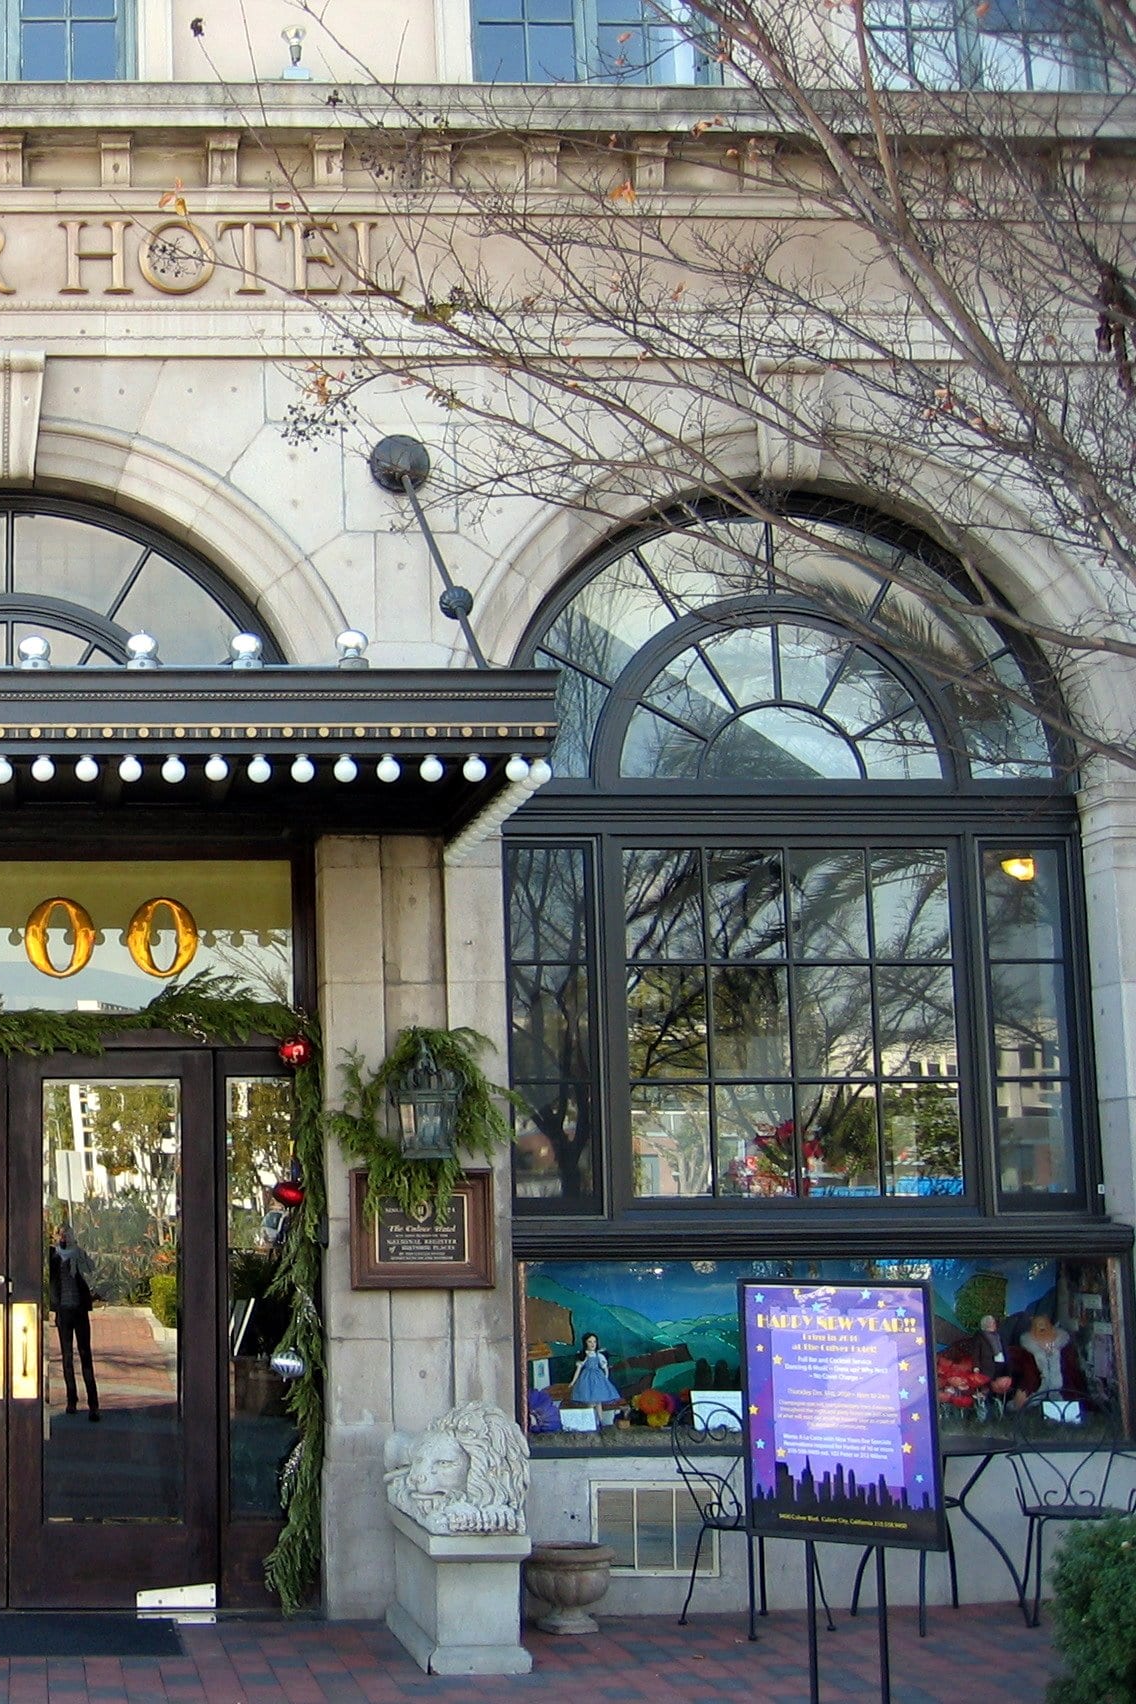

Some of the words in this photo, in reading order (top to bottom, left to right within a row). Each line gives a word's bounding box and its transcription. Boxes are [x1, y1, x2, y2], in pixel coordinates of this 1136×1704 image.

[57, 219, 405, 297] HOTEL
[757, 1313, 812, 1329] HAPPY
[816, 1315, 854, 1331] NEW
[857, 1317, 917, 1333] YEAR!!
